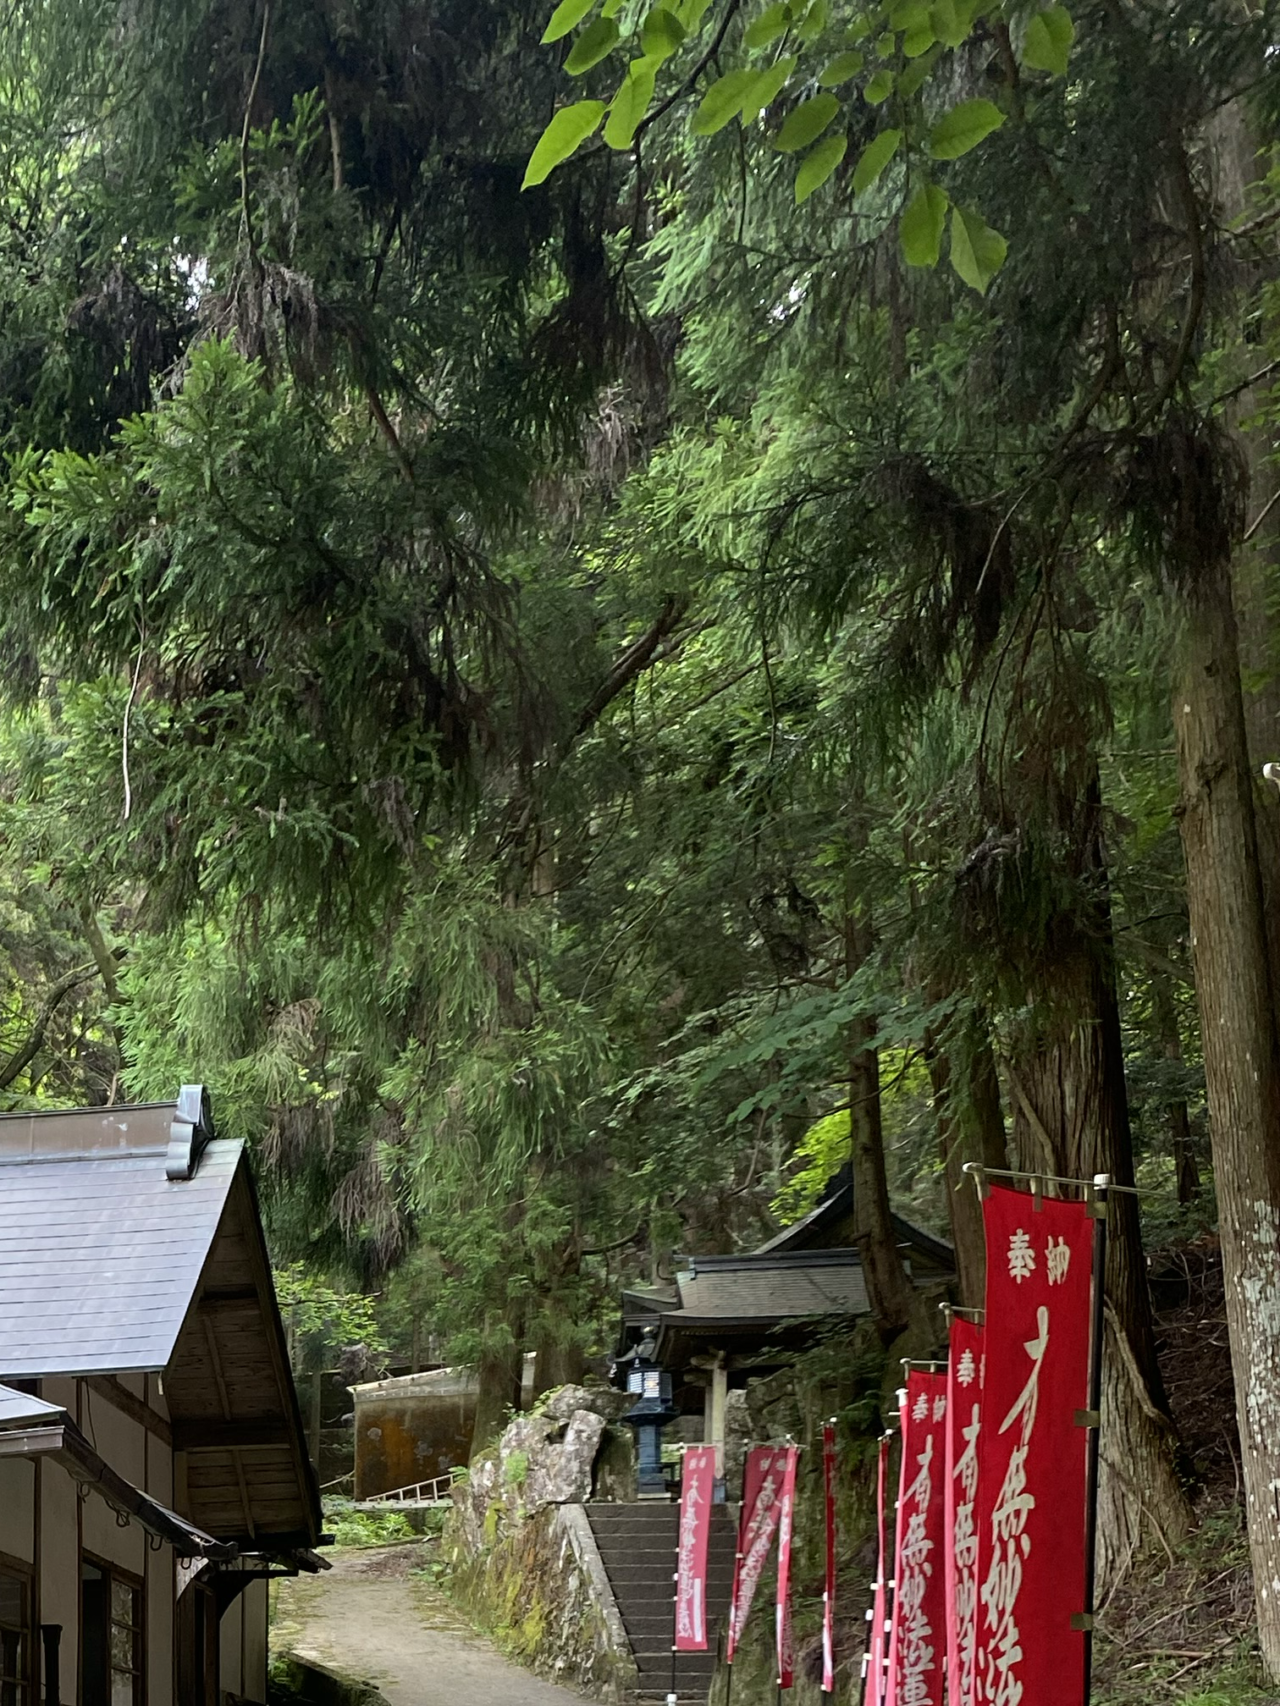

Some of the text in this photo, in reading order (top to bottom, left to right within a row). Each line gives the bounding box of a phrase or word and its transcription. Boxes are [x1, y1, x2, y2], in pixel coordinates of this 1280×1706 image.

[1006, 1227, 1072, 1287] 奉納
[955, 1347, 985, 1390] 奉
[911, 1391, 947, 1424] 奉納
